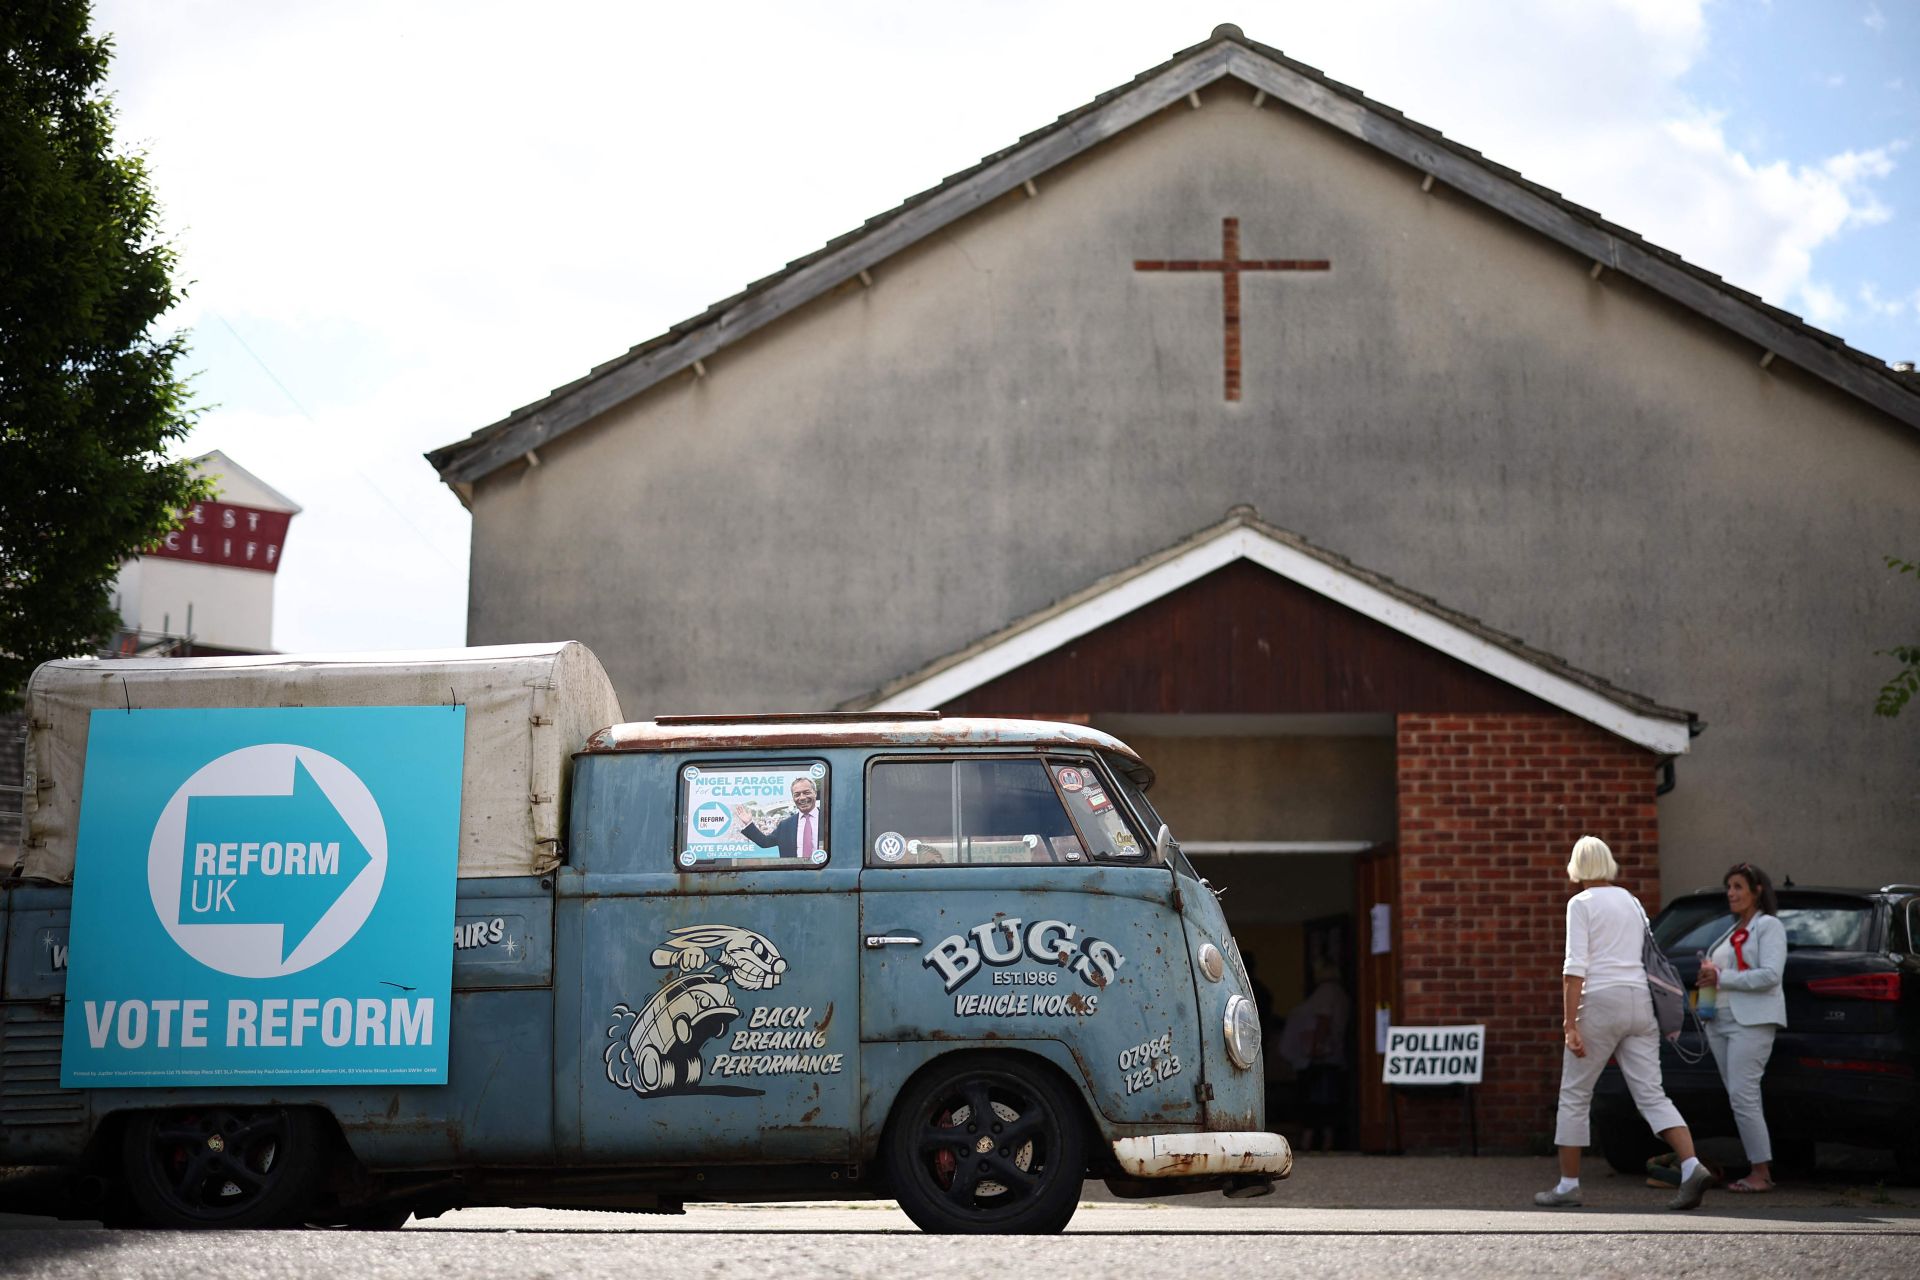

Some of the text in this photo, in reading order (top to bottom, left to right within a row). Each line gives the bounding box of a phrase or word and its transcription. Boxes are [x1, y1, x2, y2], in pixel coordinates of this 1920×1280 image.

[165, 531, 279, 563] CLIFF
[695, 776, 785, 786] NIGEL FARAGE
[711, 785, 784, 797] CLACTON
[193, 841, 340, 876] REFORM
[689, 844, 755, 852] VOTE FARAGE
[191, 879, 236, 913] UK
[922, 917, 1126, 994] BUGS
[993, 971, 1058, 986] EST. 1986
[955, 994, 1099, 1017] VEHICLE WORS
[84, 997, 434, 1049] VOTE REFORM
[748, 1006, 812, 1029] BACK
[730, 1030, 826, 1051] BREAKING
[1391, 1032, 1479, 1052] POLLING
[1117, 1033, 1171, 1072] 07984
[710, 1053, 844, 1076] PERFORMANCE
[1123, 1054, 1183, 1096] 123 123
[1389, 1056, 1477, 1075] STATION
